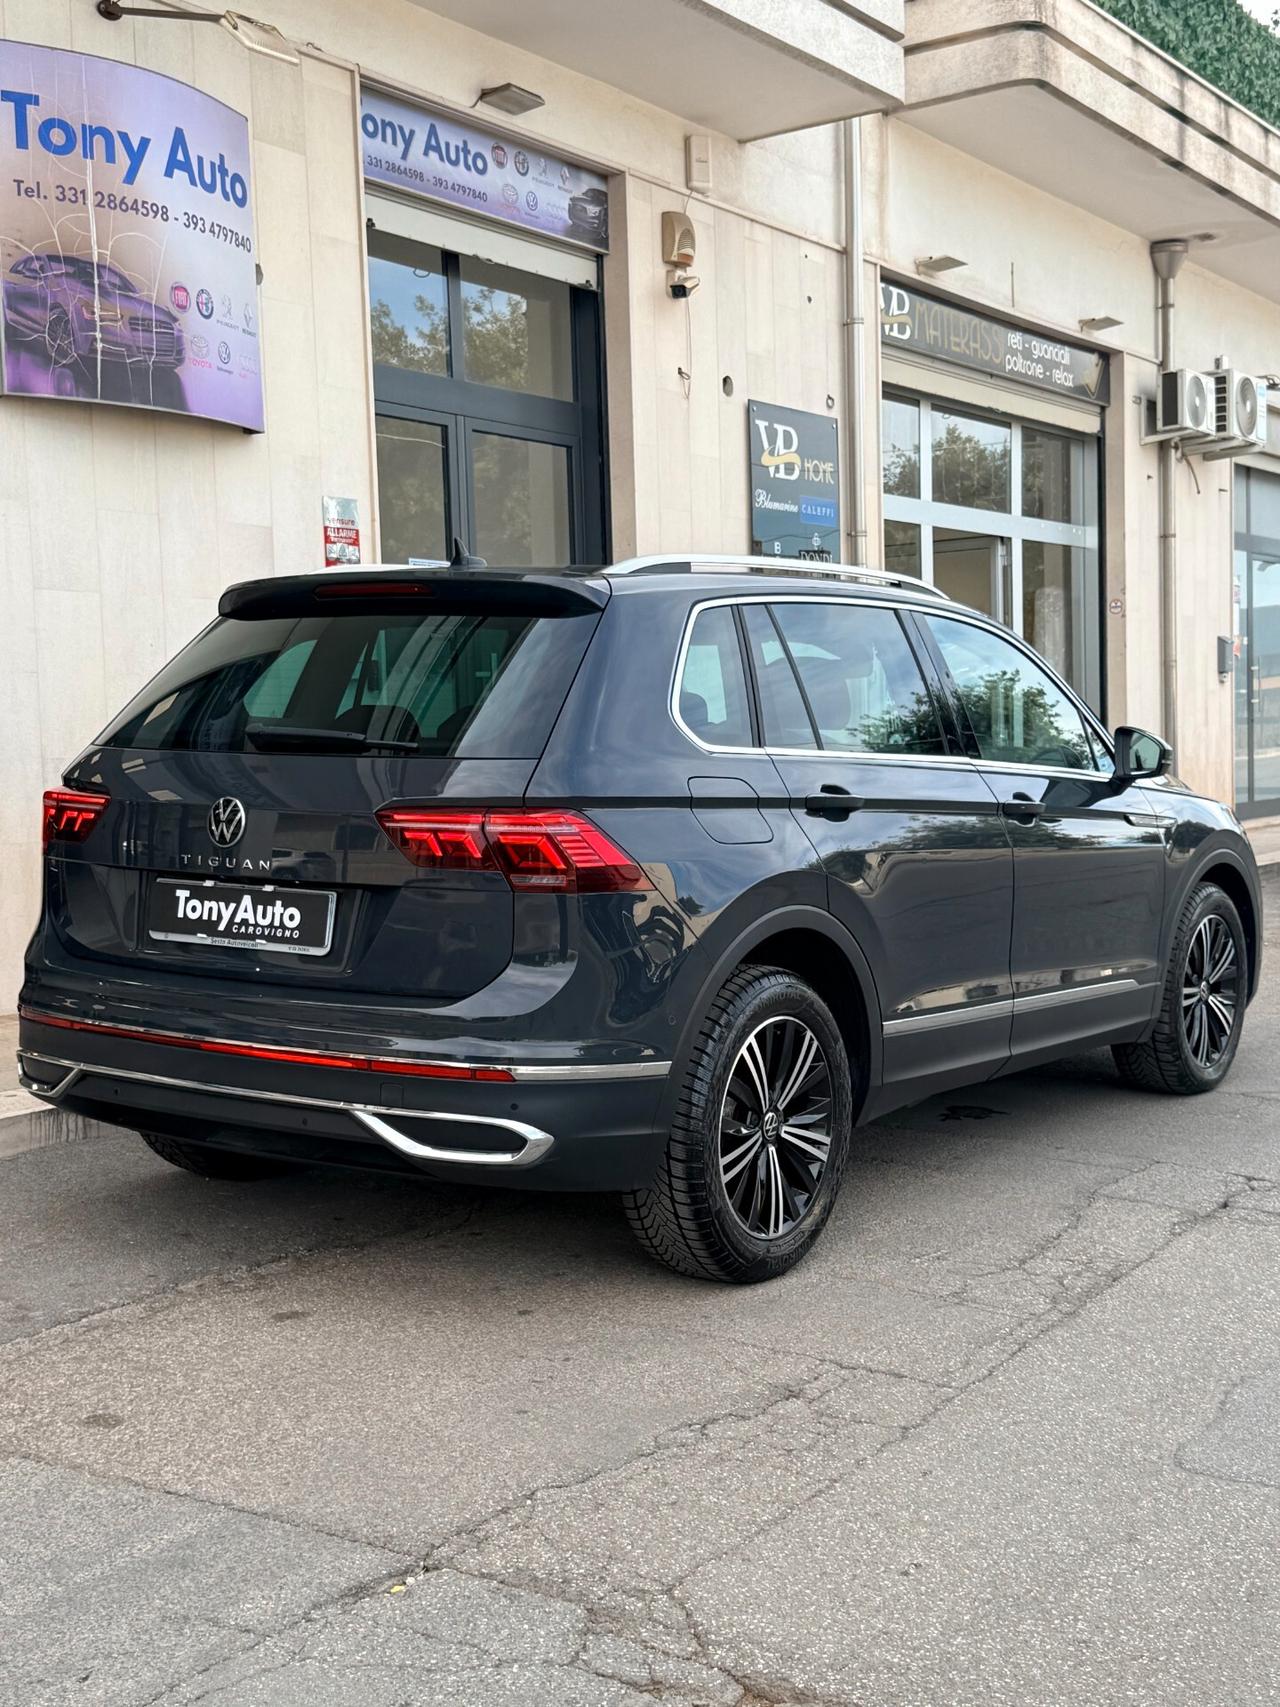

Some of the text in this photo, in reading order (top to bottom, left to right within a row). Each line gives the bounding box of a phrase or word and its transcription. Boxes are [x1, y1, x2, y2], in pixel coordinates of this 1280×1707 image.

[1, 89, 248, 208] Tony Auto
[361, 113, 488, 176] ony Auto
[367, 155, 382, 169] 331
[385, 161, 424, 182] 2864598
[432, 176, 448, 190] 393
[451, 184, 488, 202] 4797840
[13, 179, 48, 200] Tel.
[55, 184, 87, 205] 331
[94, 191, 169, 222] 2864598
[183, 212, 206, 234] 393
[209, 221, 252, 253] 4797840
[1008, 332, 1023, 350] reti
[1005, 353, 1044, 379] poltrone
[1052, 367, 1074, 387] relax
[755, 419, 801, 480] VB
[804, 458, 834, 484] HOME
[801, 504, 834, 517] CALEFFI
[181, 854, 271, 870] TIGUAN
[175, 889, 301, 931] TonyAuto
[232, 924, 300, 939] CAROVIGNO
